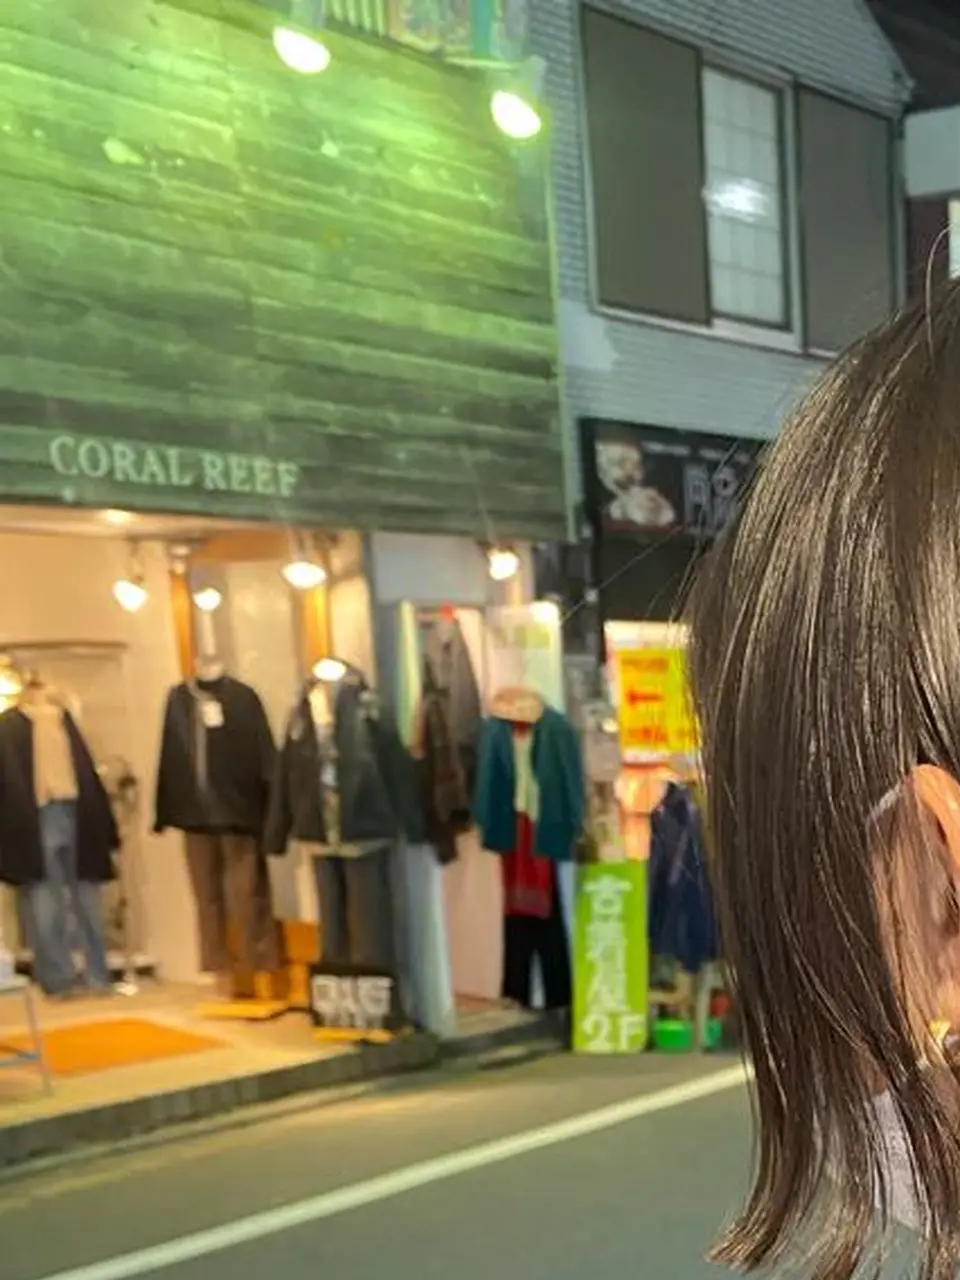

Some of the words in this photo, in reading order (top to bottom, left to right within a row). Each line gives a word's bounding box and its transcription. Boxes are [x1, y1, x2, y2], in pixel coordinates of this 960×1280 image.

[48, 435, 192, 486] CORAL
[200, 451, 302, 497] REEF
[581, 1014, 646, 1052] 2F
